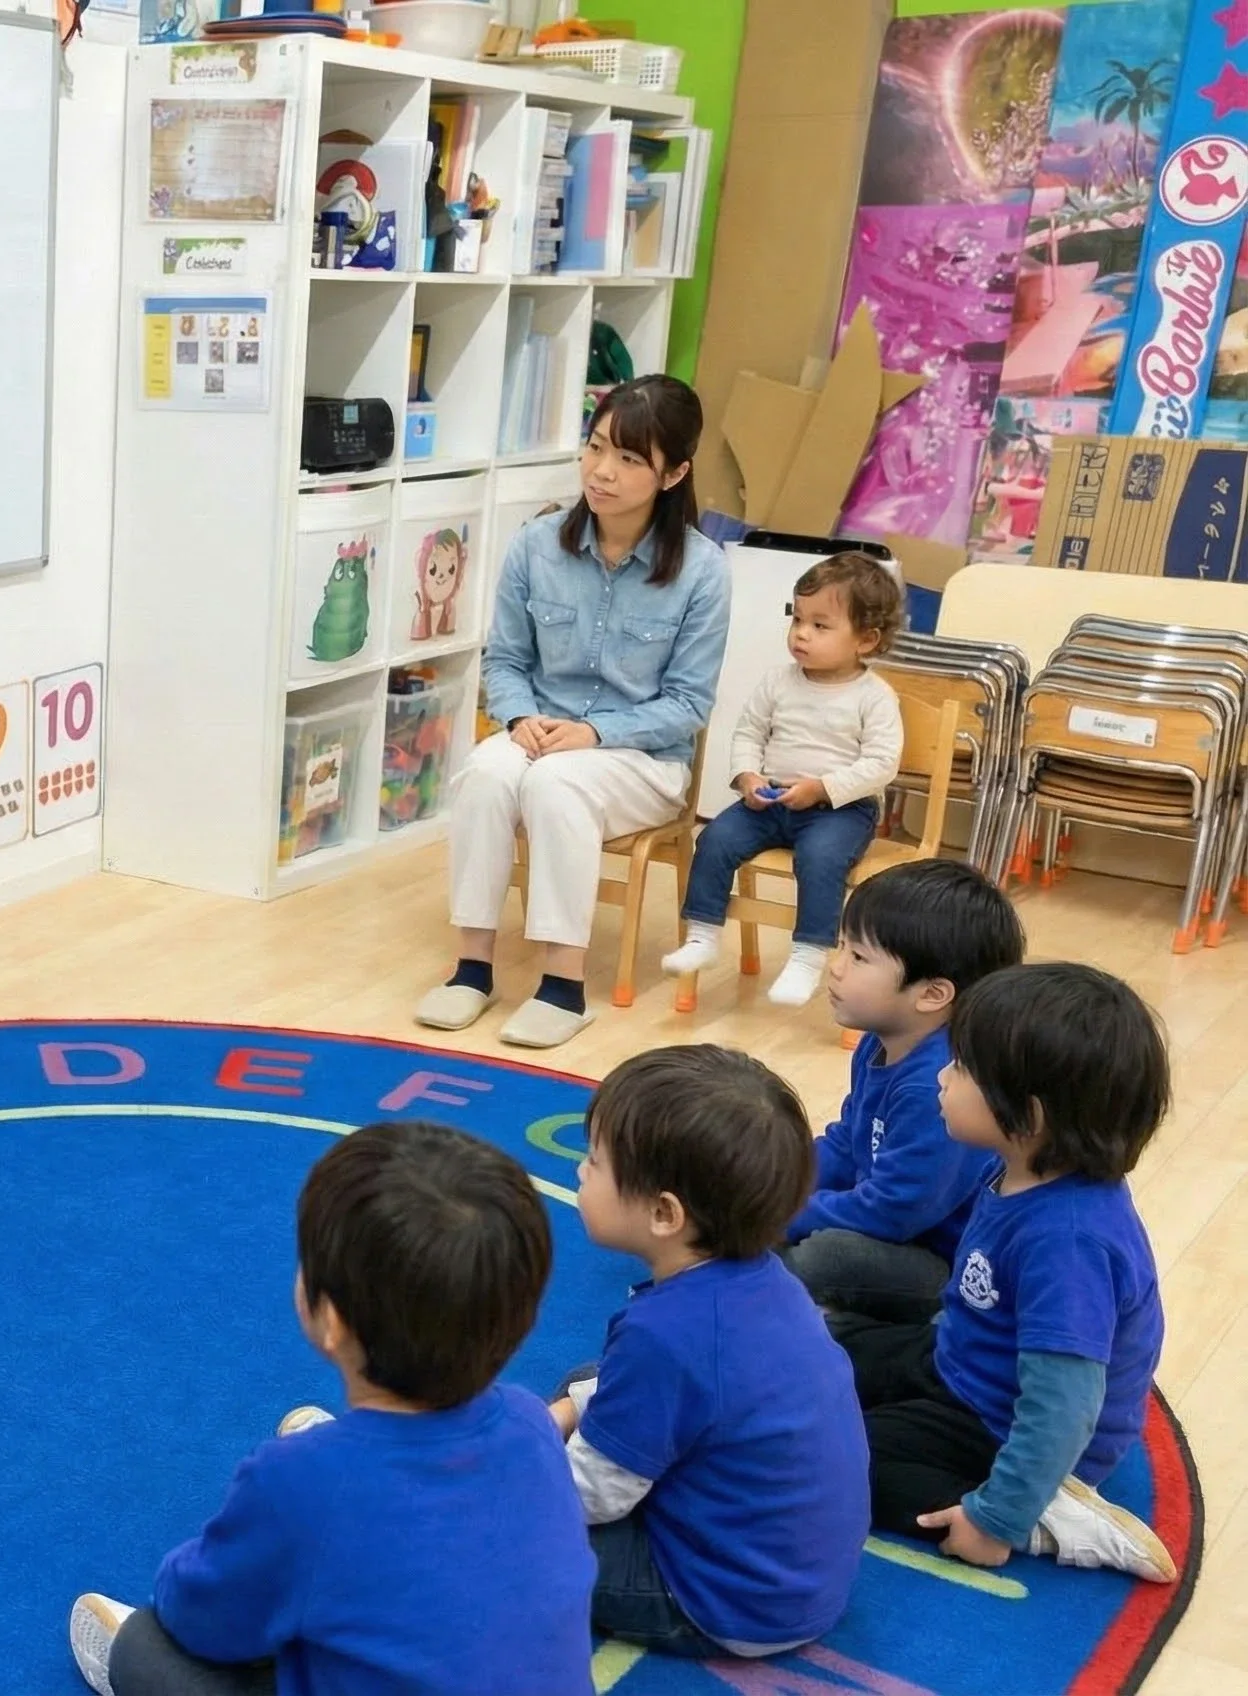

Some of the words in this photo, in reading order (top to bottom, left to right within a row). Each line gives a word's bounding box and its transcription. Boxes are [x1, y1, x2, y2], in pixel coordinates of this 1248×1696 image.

[1141, 245, 1223, 396] Barbie
[41, 681, 94, 748] 10
[38, 1041, 146, 1086] D
[215, 1048, 313, 1097] E
[377, 1071, 495, 1112] F
